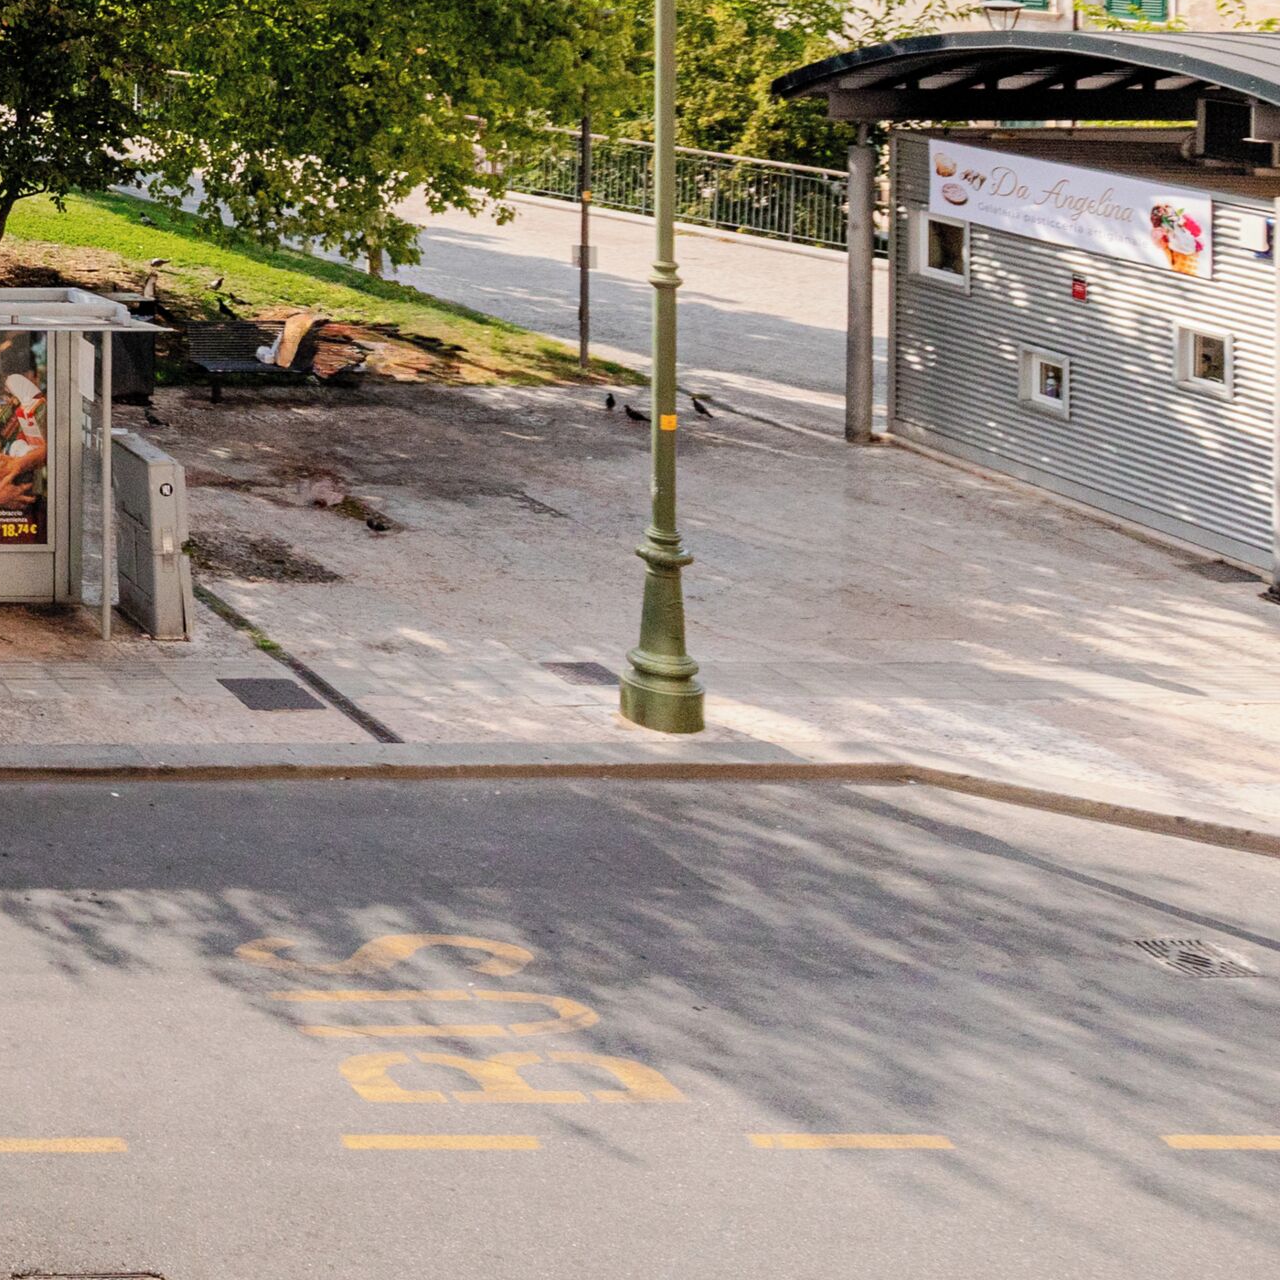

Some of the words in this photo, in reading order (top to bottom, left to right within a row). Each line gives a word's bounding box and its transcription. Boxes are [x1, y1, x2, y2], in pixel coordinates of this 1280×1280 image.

[990, 166, 1030, 200] Da
[1034, 179, 1135, 222] Angelina
[235, 933, 694, 1103] BUS
